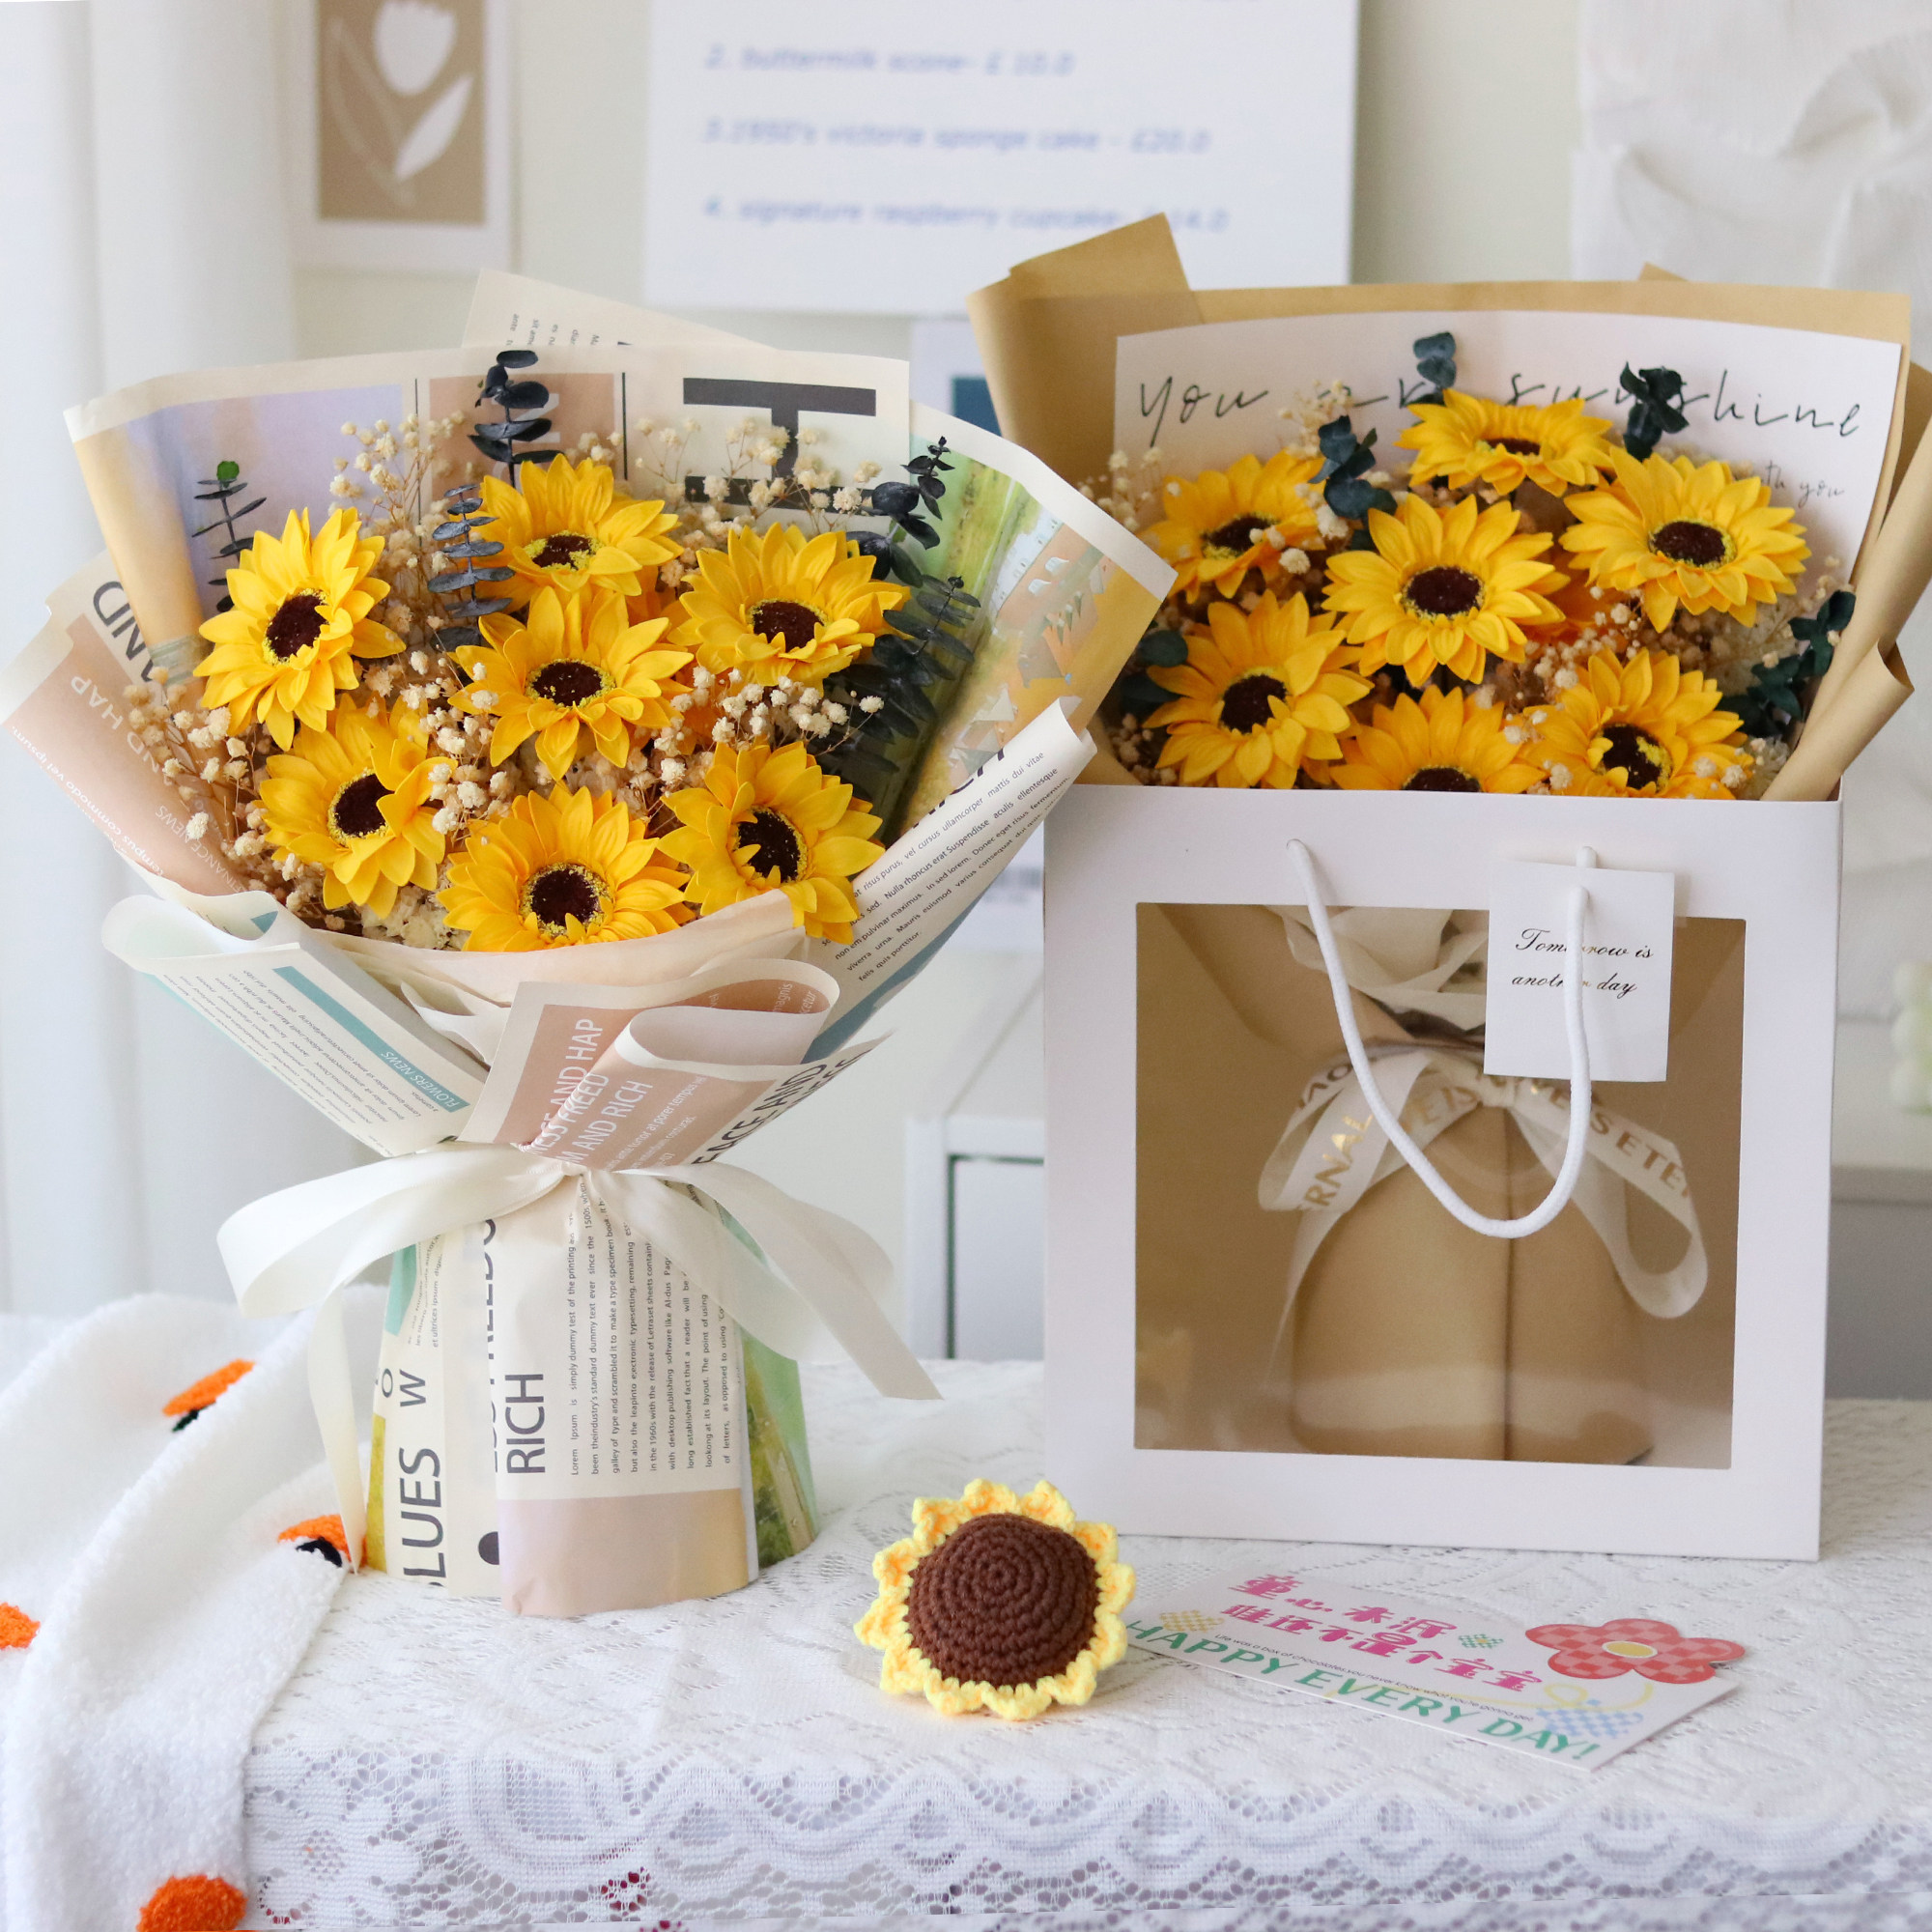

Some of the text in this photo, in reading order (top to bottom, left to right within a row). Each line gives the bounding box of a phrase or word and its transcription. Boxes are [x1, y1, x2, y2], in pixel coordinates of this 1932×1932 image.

[1139, 376, 1269, 447] You
[65, 781, 124, 837] commodo
[863, 875, 880, 890] risus
[903, 847, 916, 859] vel
[918, 830, 940, 849] cursus
[942, 798, 982, 831] ullamcorper
[987, 778, 1009, 797] mattis
[1011, 767, 1024, 779] dui
[1026, 753, 1043, 767] vitae
[884, 768, 1057, 898] Nulla rhoncus erat Suspendisse aculis ellentesque
[835, 947, 850, 959] non
[861, 917, 890, 940] pulvinar
[934, 871, 949, 884] sed
[971, 837, 995, 855] Donec
[995, 824, 1011, 838] eget
[1011, 810, 1029, 825] risus
[846, 952, 871, 971] viverra
[895, 914, 921, 932] Mauris
[922, 888, 952, 913] euismod
[1515, 927, 1655, 959] Tomrow is
[1511, 972, 1638, 1000] anotr day
[565, 1017, 604, 1062] HAP
[381, 1049, 459, 1111] FLOWERS NEWS
[557, 1072, 611, 1126] FREED
[582, 1110, 619, 1153] AND
[602, 1079, 654, 1126] RICH
[567, 1246, 576, 1279] printing
[608, 1238, 616, 1278] specimen
[682, 1280, 689, 1291] be
[567, 1298, 575, 1307] of
[629, 1286, 638, 1335] typesetting,
[588, 1321, 598, 1353] dummy
[610, 1334, 617, 1344] to
[700, 1319, 708, 1327] of
[568, 1328, 577, 1361] dummy
[646, 1341, 654, 1350] of
[721, 1352, 726, 1361] to
[568, 1362, 578, 1390] simply
[588, 1357, 597, 1394] standard
[666, 1368, 675, 1412] publishing
[702, 1377, 711, 1406] layout.
[720, 1365, 728, 1401] opposed
[610, 1398, 618, 1413] and
[630, 1383, 639, 1417] leapinto
[504, 1373, 546, 1474] RICH
[570, 1414, 580, 1439] Ipsum
[684, 1399, 693, 1445] established
[704, 1423, 711, 1432] at
[610, 1437, 618, 1447] of
[687, 1449, 696, 1468] long
[590, 1453, 599, 1474] been
[611, 1448, 620, 1473] galley
[398, 1446, 447, 1588] LUES
[1125, 1619, 1603, 1761] HAPPY EVERY DAY!
